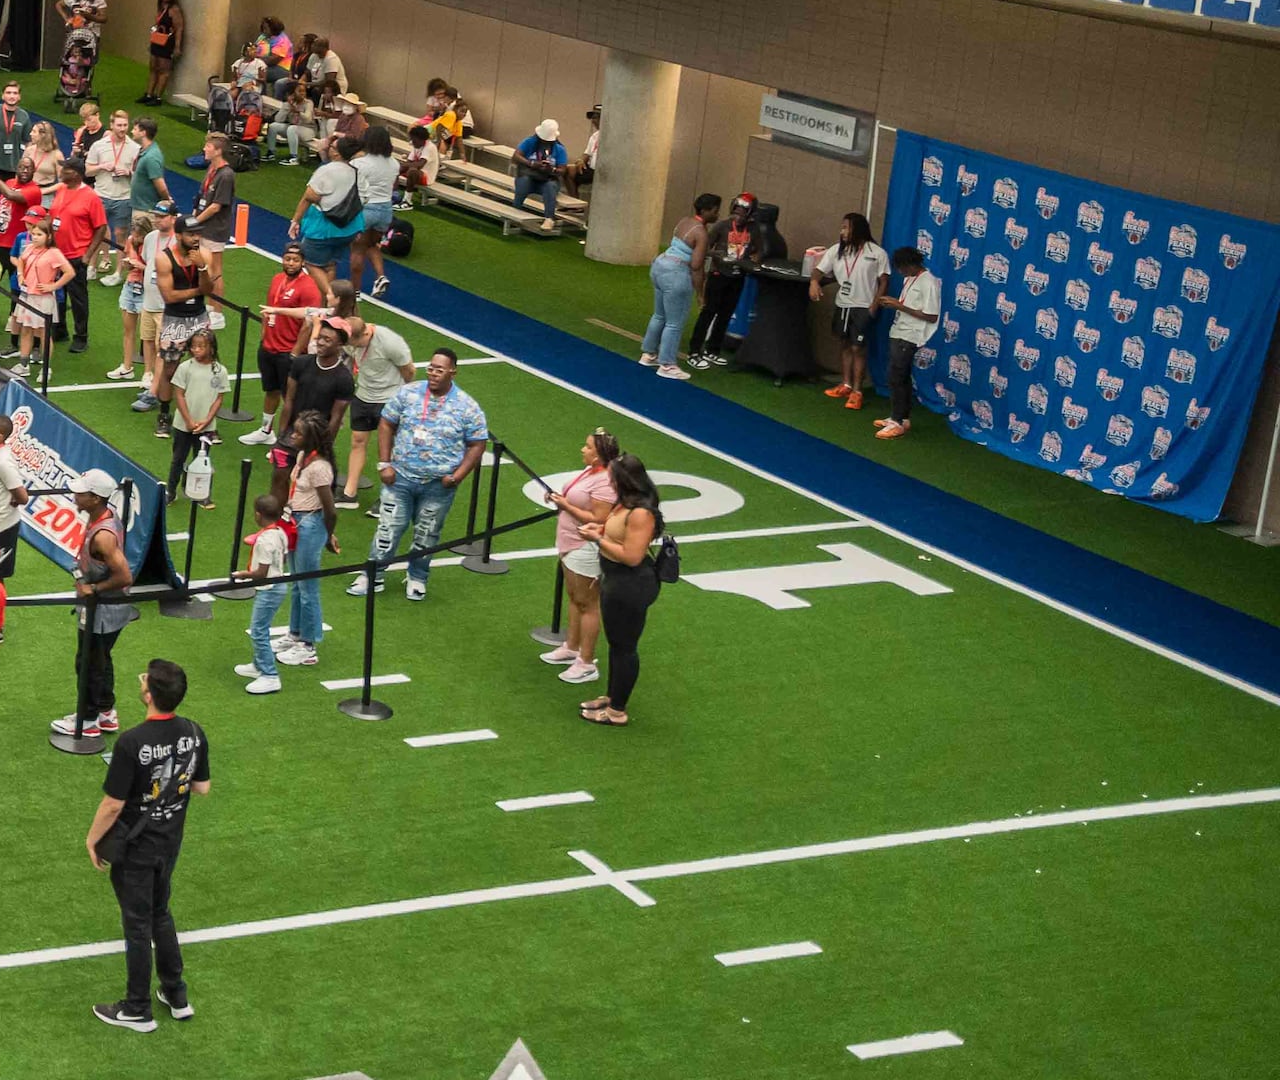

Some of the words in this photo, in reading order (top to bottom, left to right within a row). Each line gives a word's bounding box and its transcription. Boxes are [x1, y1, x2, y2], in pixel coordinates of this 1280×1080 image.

[764, 104, 833, 134] RESTROOMS
[40, 456, 76, 491] PEAC
[33, 500, 87, 554] ZON
[139, 743, 173, 765] Other
